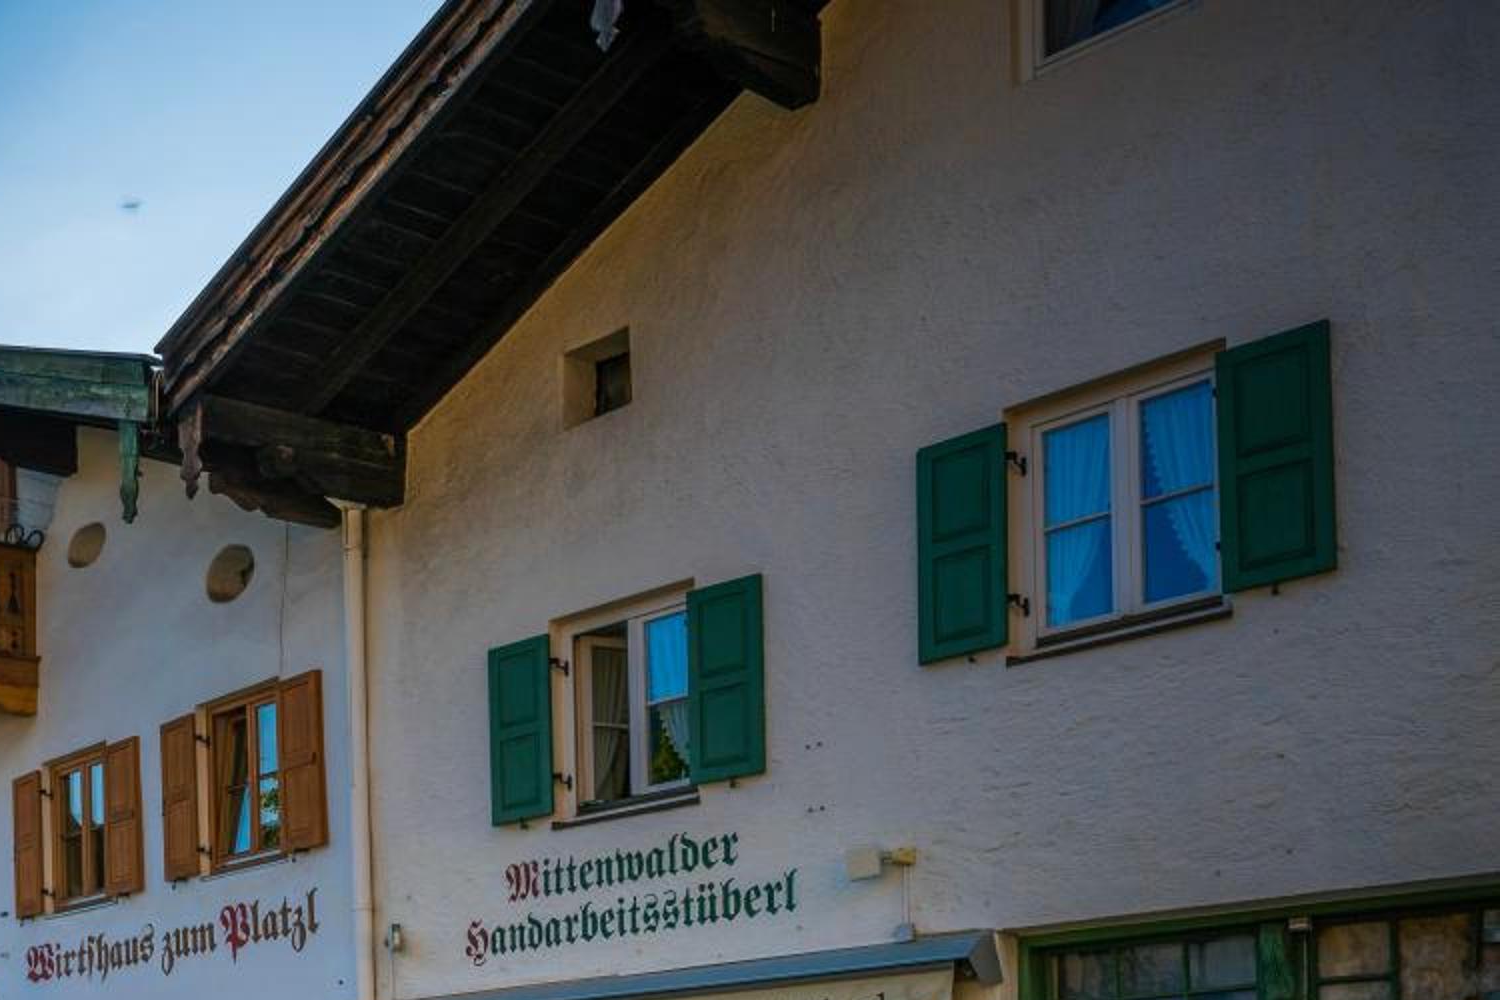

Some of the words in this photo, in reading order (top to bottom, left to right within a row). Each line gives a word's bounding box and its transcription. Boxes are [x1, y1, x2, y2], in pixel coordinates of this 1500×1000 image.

[505, 831, 739, 903] Mittenwalder
[161, 921, 218, 976] zum
[220, 887, 319, 964] Platzl
[465, 868, 799, 967] Handarbeitsstüberl
